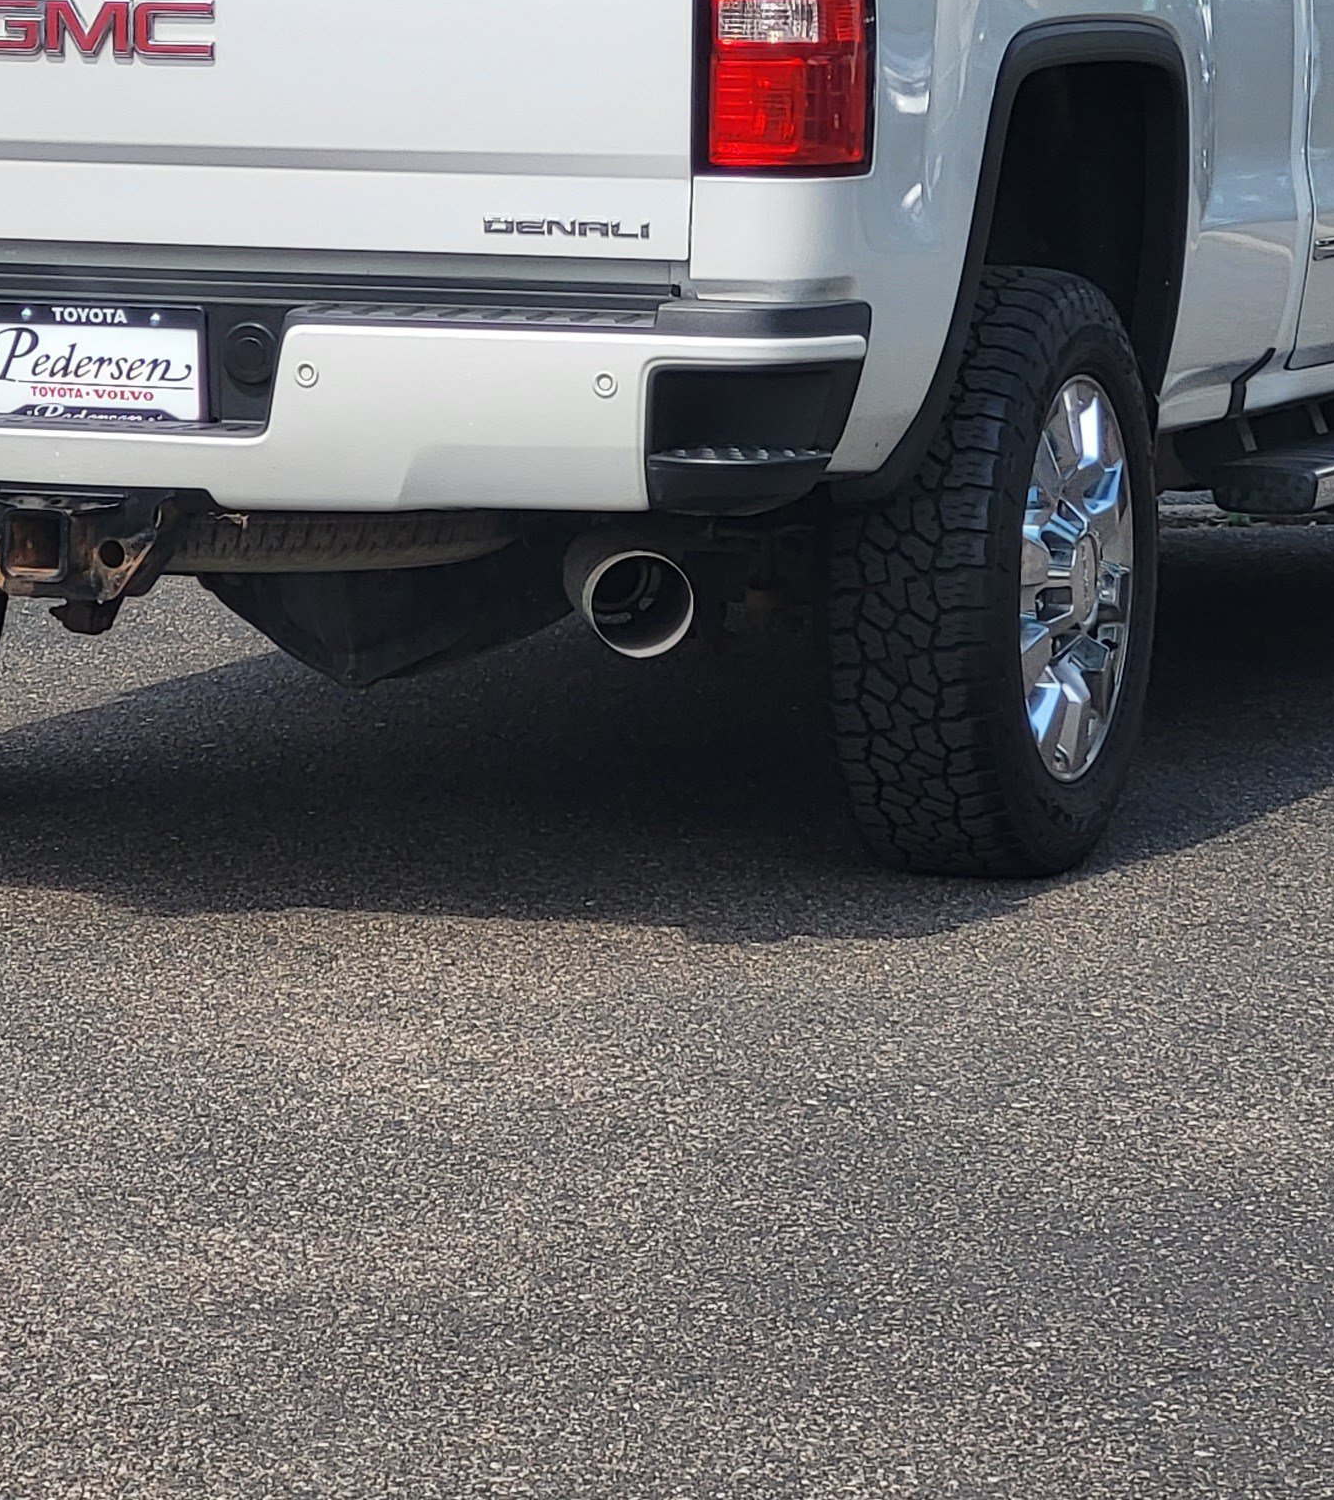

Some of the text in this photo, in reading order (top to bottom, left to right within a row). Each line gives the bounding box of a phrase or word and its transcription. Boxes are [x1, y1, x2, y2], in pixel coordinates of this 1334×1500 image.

[483, 215, 651, 240] DENALI
[52, 307, 128, 324] TOYOTA
[30, 386, 154, 401] TOYOTA VOLVO
